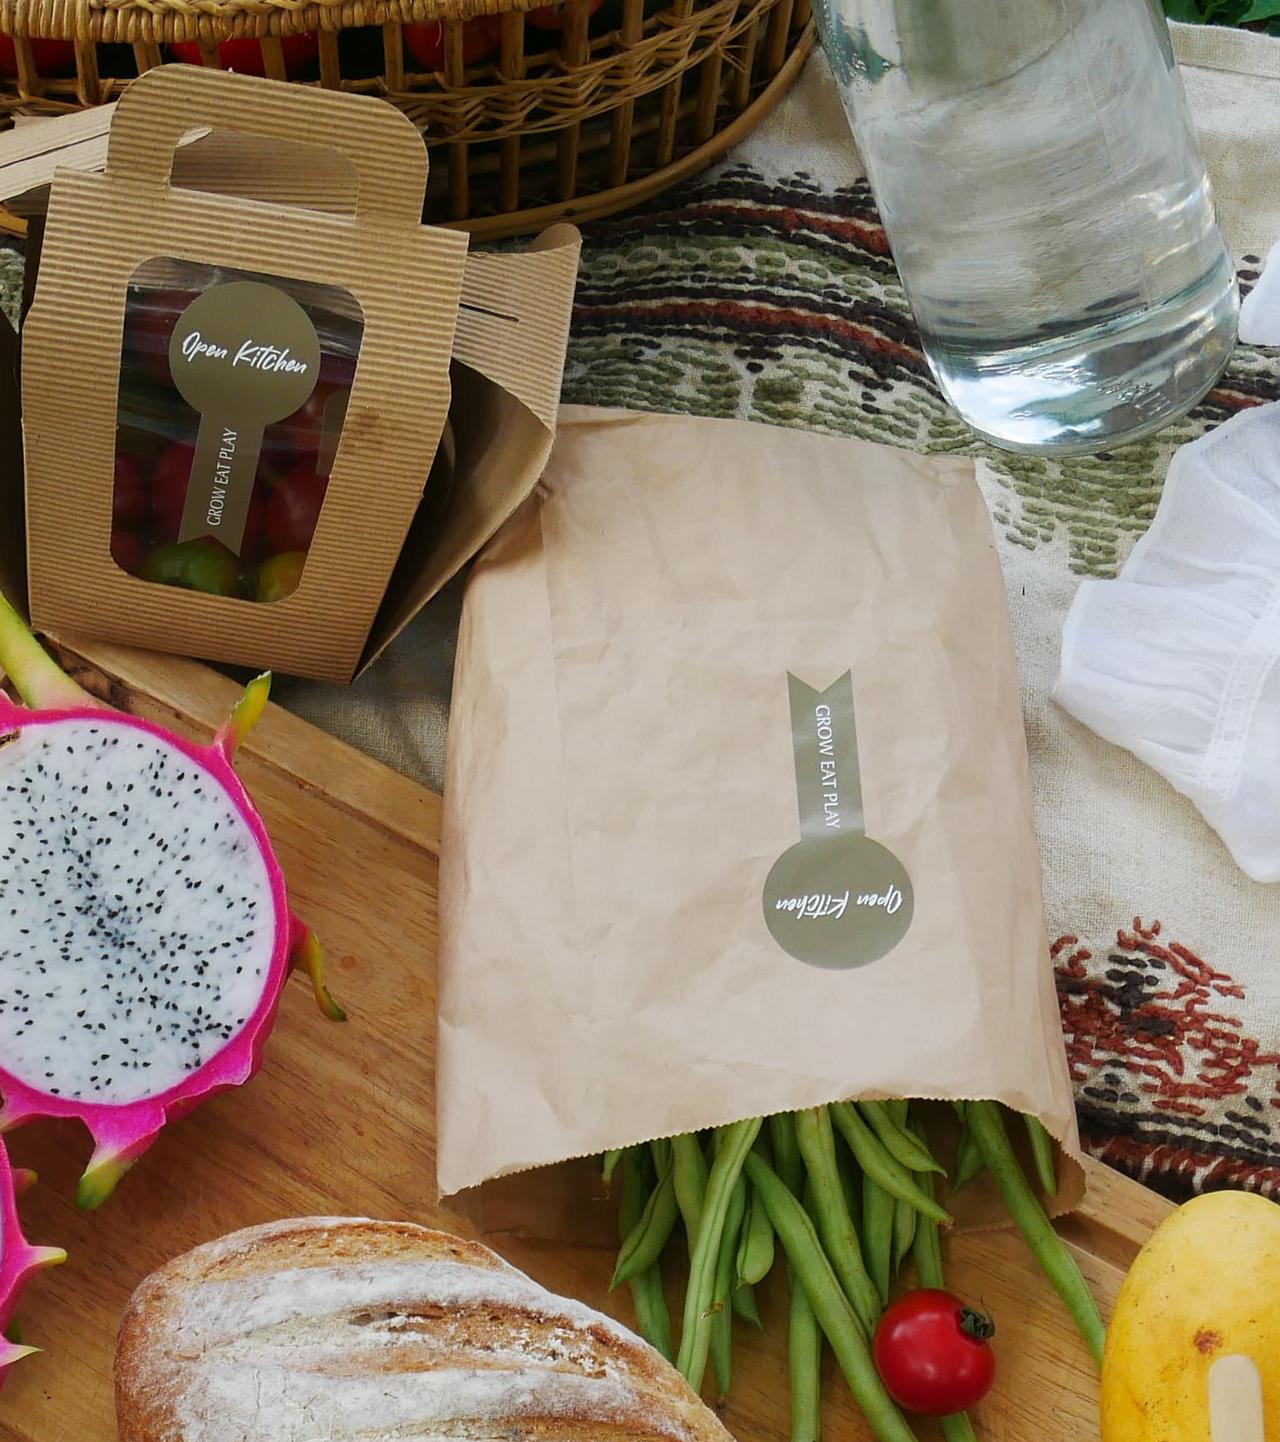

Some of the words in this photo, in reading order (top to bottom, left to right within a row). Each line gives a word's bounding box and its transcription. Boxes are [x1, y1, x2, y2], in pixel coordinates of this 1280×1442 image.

[182, 331, 228, 362] Open
[232, 340, 308, 373] Kitchen
[219, 427, 238, 460] PLAY
[214, 461, 231, 485] EAT
[206, 486, 226, 526] GROW
[815, 704, 834, 756] GROW
[820, 761, 837, 788] EAT
[823, 793, 841, 829] PLAY
[775, 891, 849, 919] Kitchen
[856, 884, 902, 914] Open
